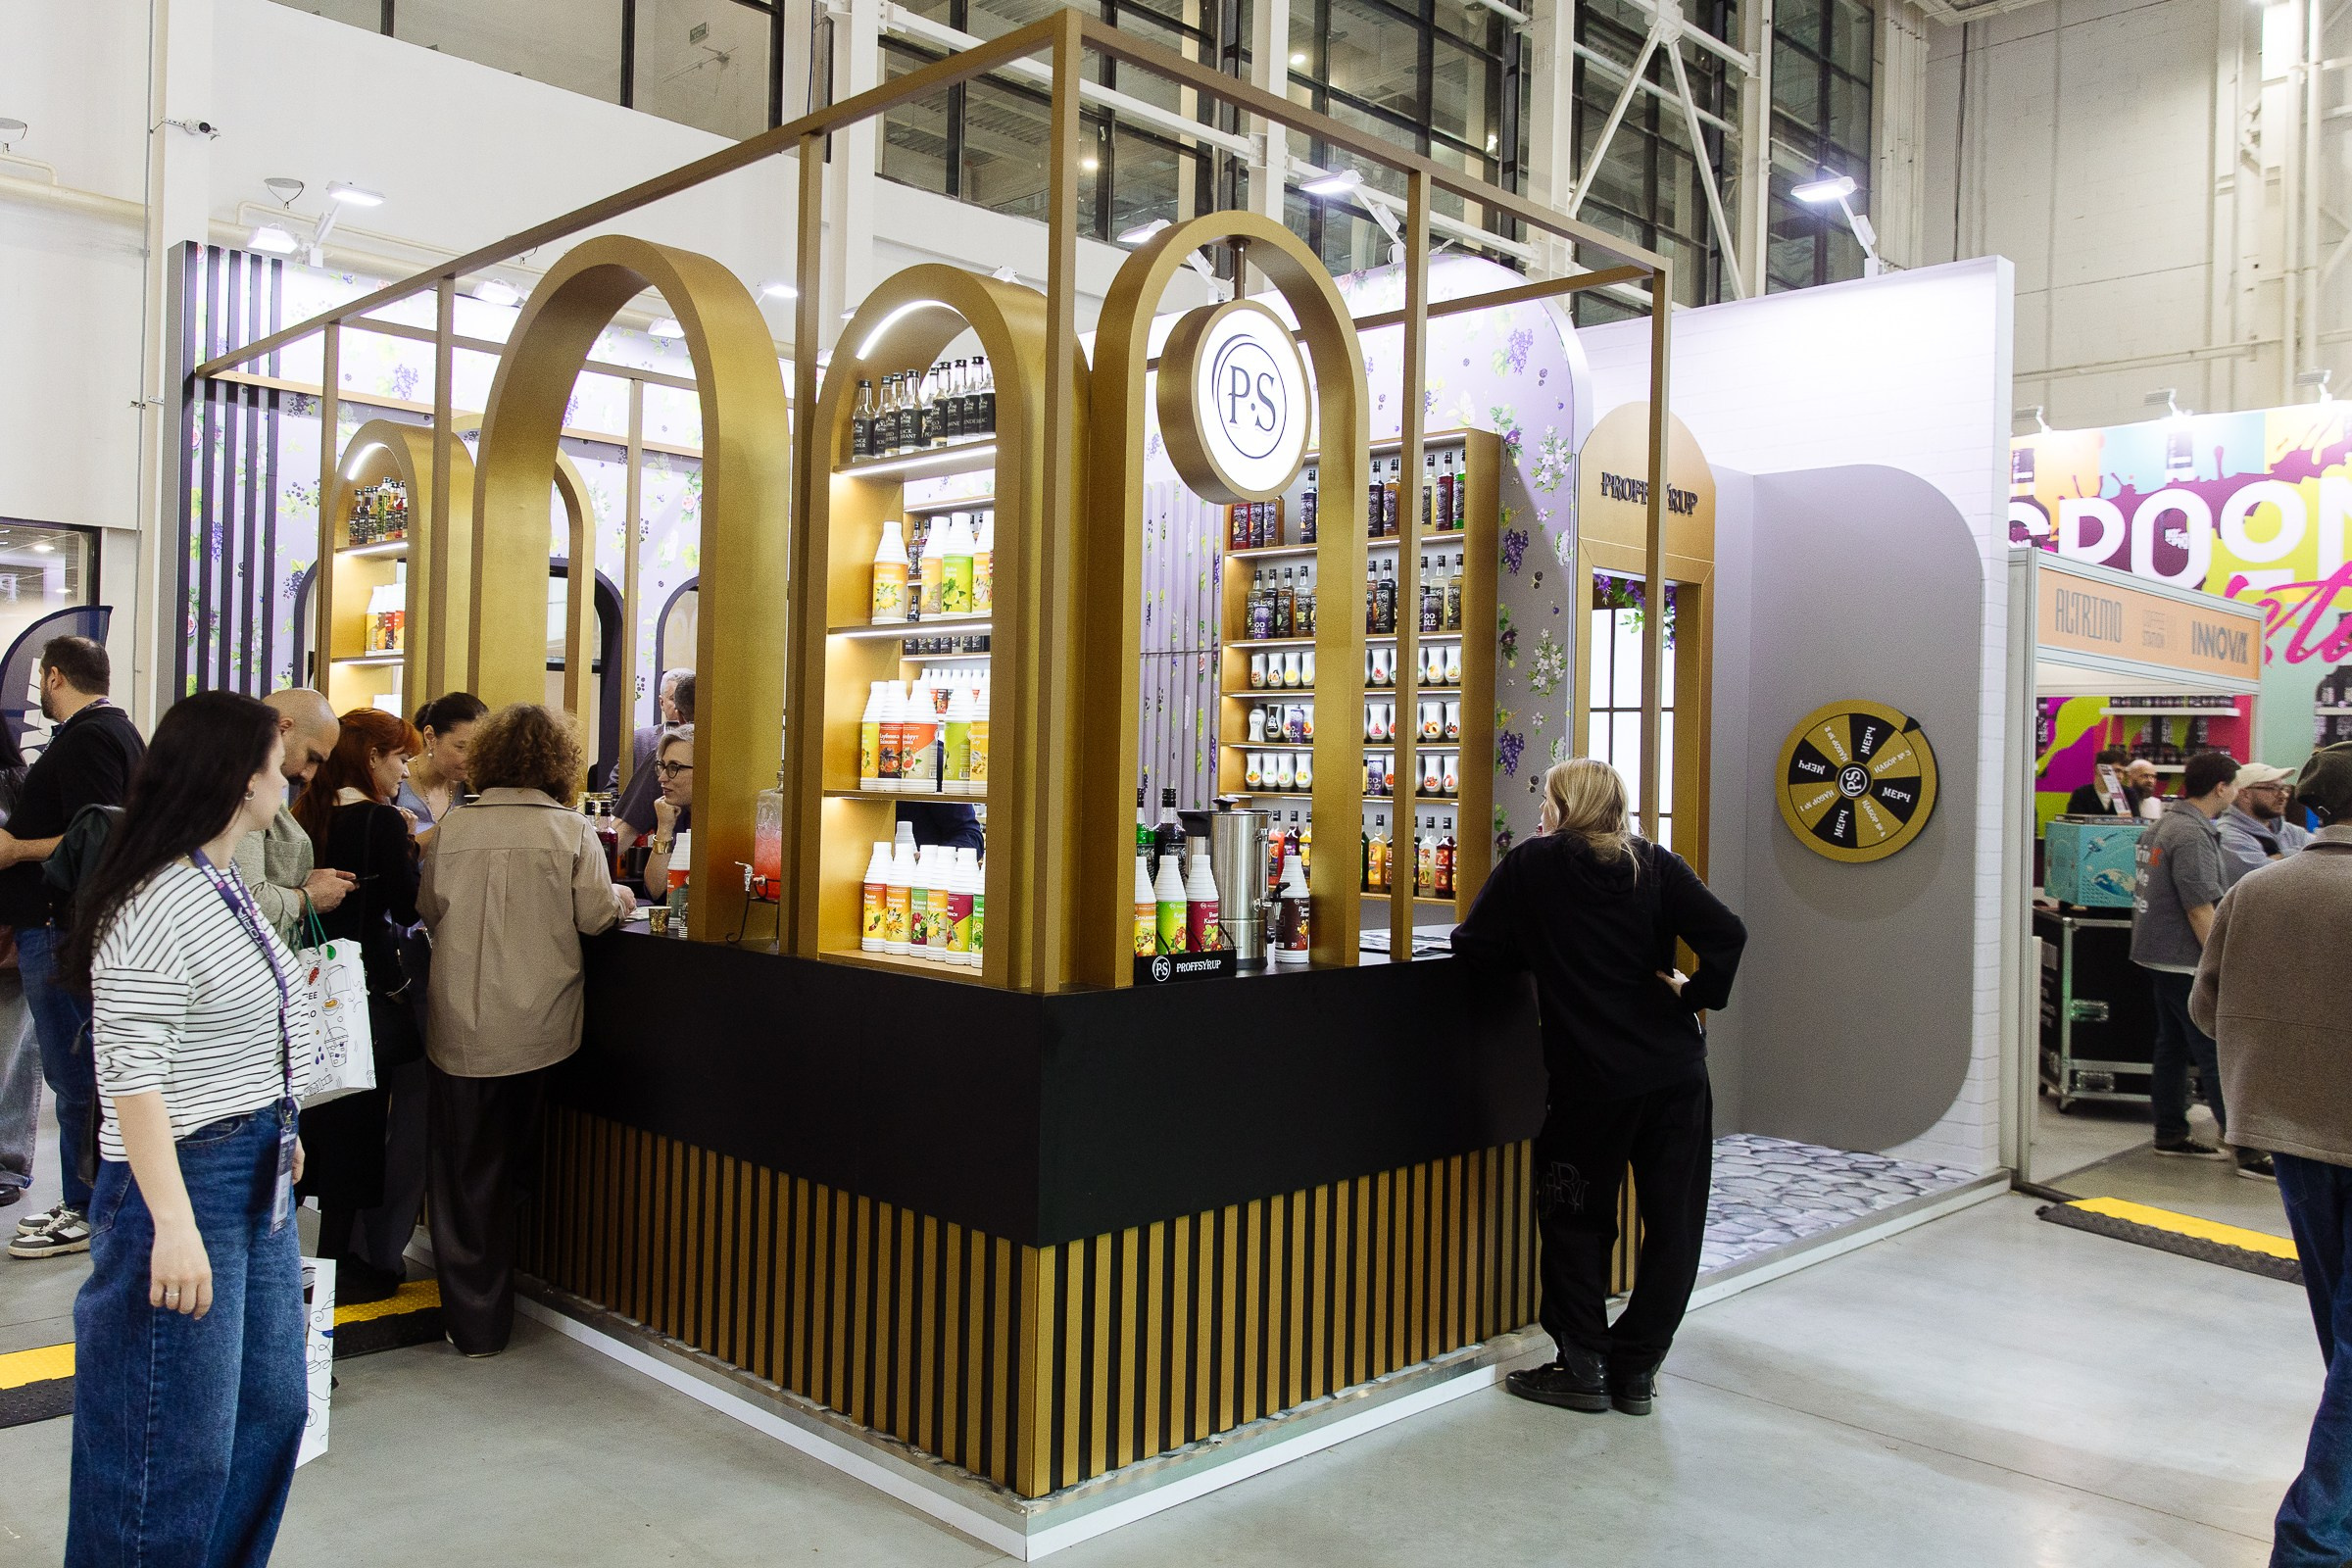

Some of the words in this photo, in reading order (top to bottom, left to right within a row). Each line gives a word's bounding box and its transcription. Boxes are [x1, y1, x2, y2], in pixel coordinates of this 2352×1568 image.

[1860, 726, 1877, 755] МЕРЧ
[1798, 760, 1825, 775] МЕРЧ
[1882, 787, 1911, 803] МЕРЧ
[1834, 809, 1849, 838] МЕРЧ
[1176, 958, 1221, 973] PROFFSYRUP
